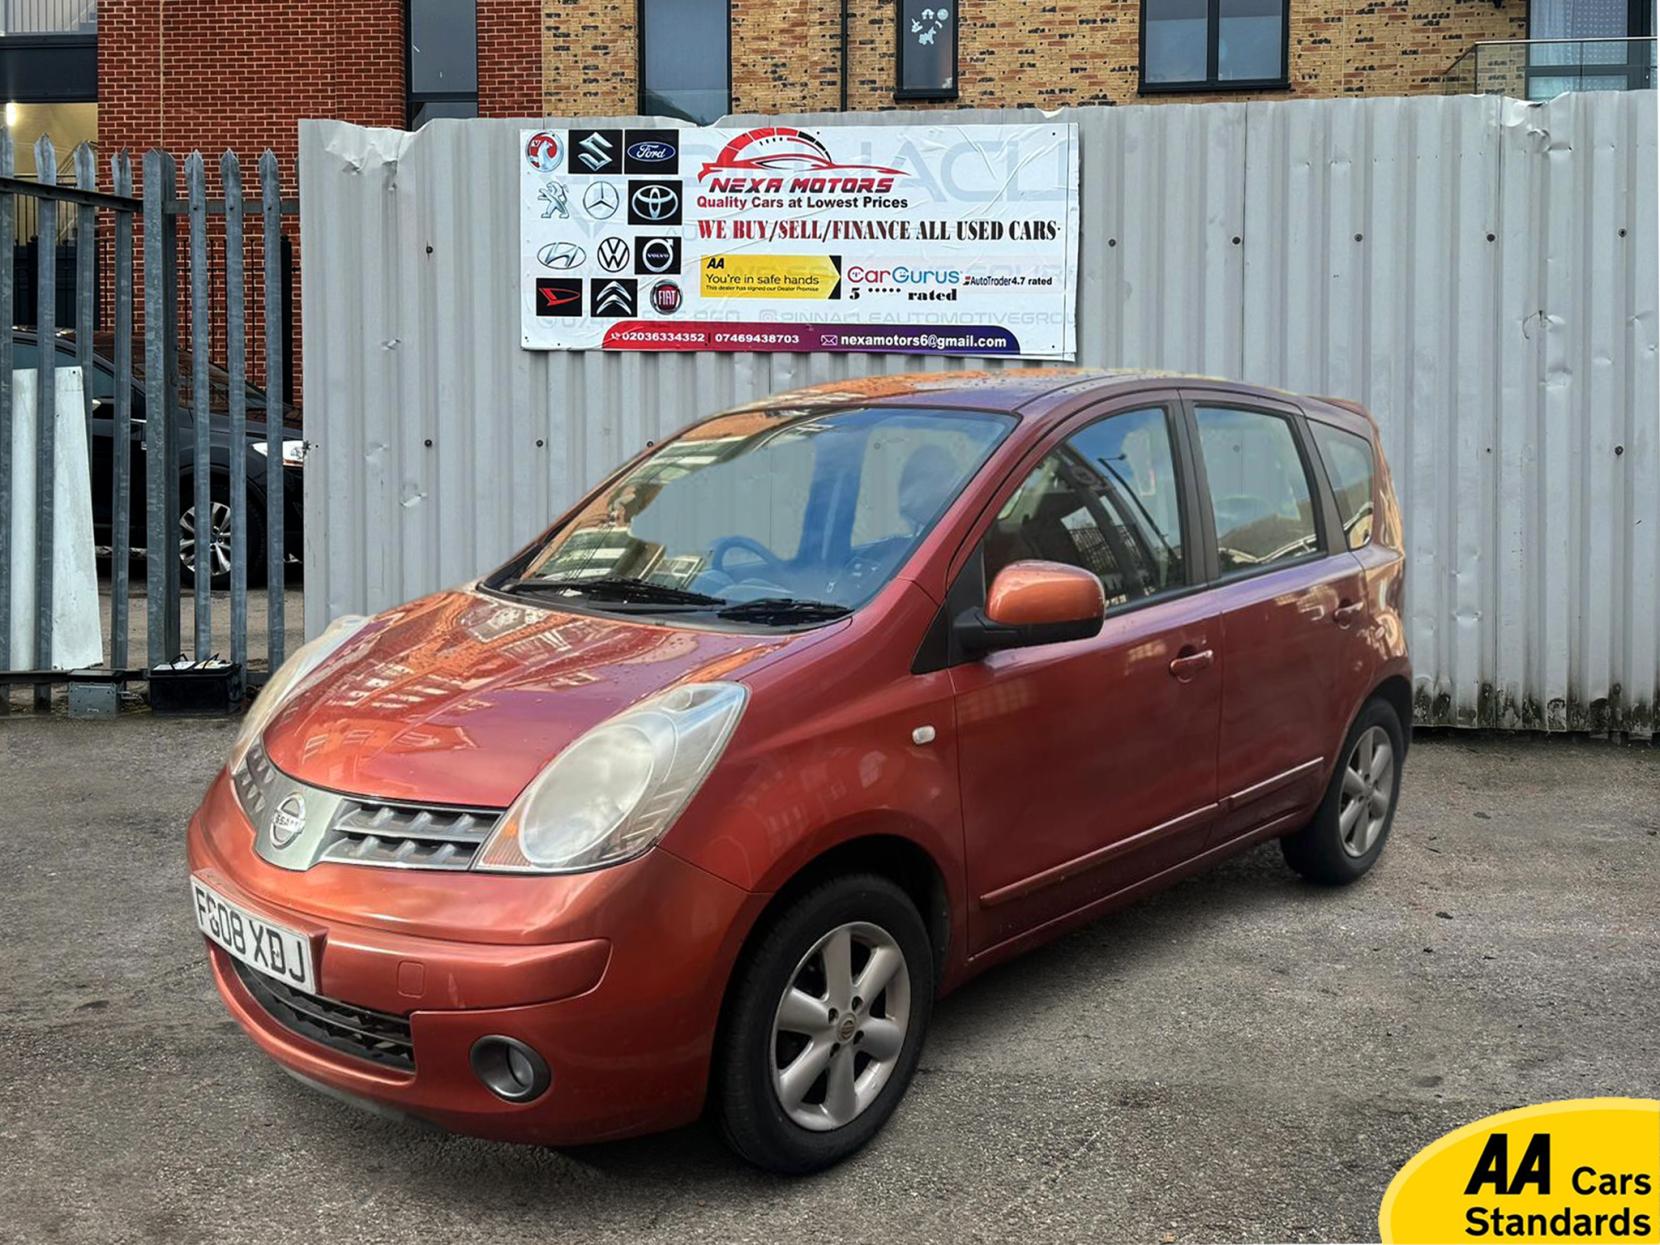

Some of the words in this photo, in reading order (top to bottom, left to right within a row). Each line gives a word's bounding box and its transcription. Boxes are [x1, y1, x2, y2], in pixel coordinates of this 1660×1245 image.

[636, 144, 667, 158] Ford
[709, 177, 784, 193] NEXA
[789, 177, 894, 193] MOTORS
[697, 196, 747, 210] Quality
[752, 196, 784, 208] Cars
[788, 197, 802, 208] at
[807, 196, 858, 208] Lowest
[863, 196, 908, 208] Prices
[697, 220, 727, 240] WE
[916, 220, 950, 240] ALL
[956, 221, 1004, 240] USED
[1008, 221, 1058, 241] CARS
[706, 257, 725, 269] AA
[706, 273, 741, 284] You're
[744, 273, 754, 284] in
[757, 273, 781, 284] safe
[784, 274, 819, 285] hands
[847, 265, 960, 285] CarGurus
[1028, 276, 1053, 286] rated
[658, 290, 676, 306] FIAT
[849, 287, 861, 300] 5
[908, 288, 957, 301] rated
[622, 332, 705, 342] 02036334352
[715, 333, 800, 344] 07469438703
[841, 334, 1007, 349] nexamotors6@gmail.com
[195, 886, 246, 956] FG08
[249, 918, 306, 984] XDJ
